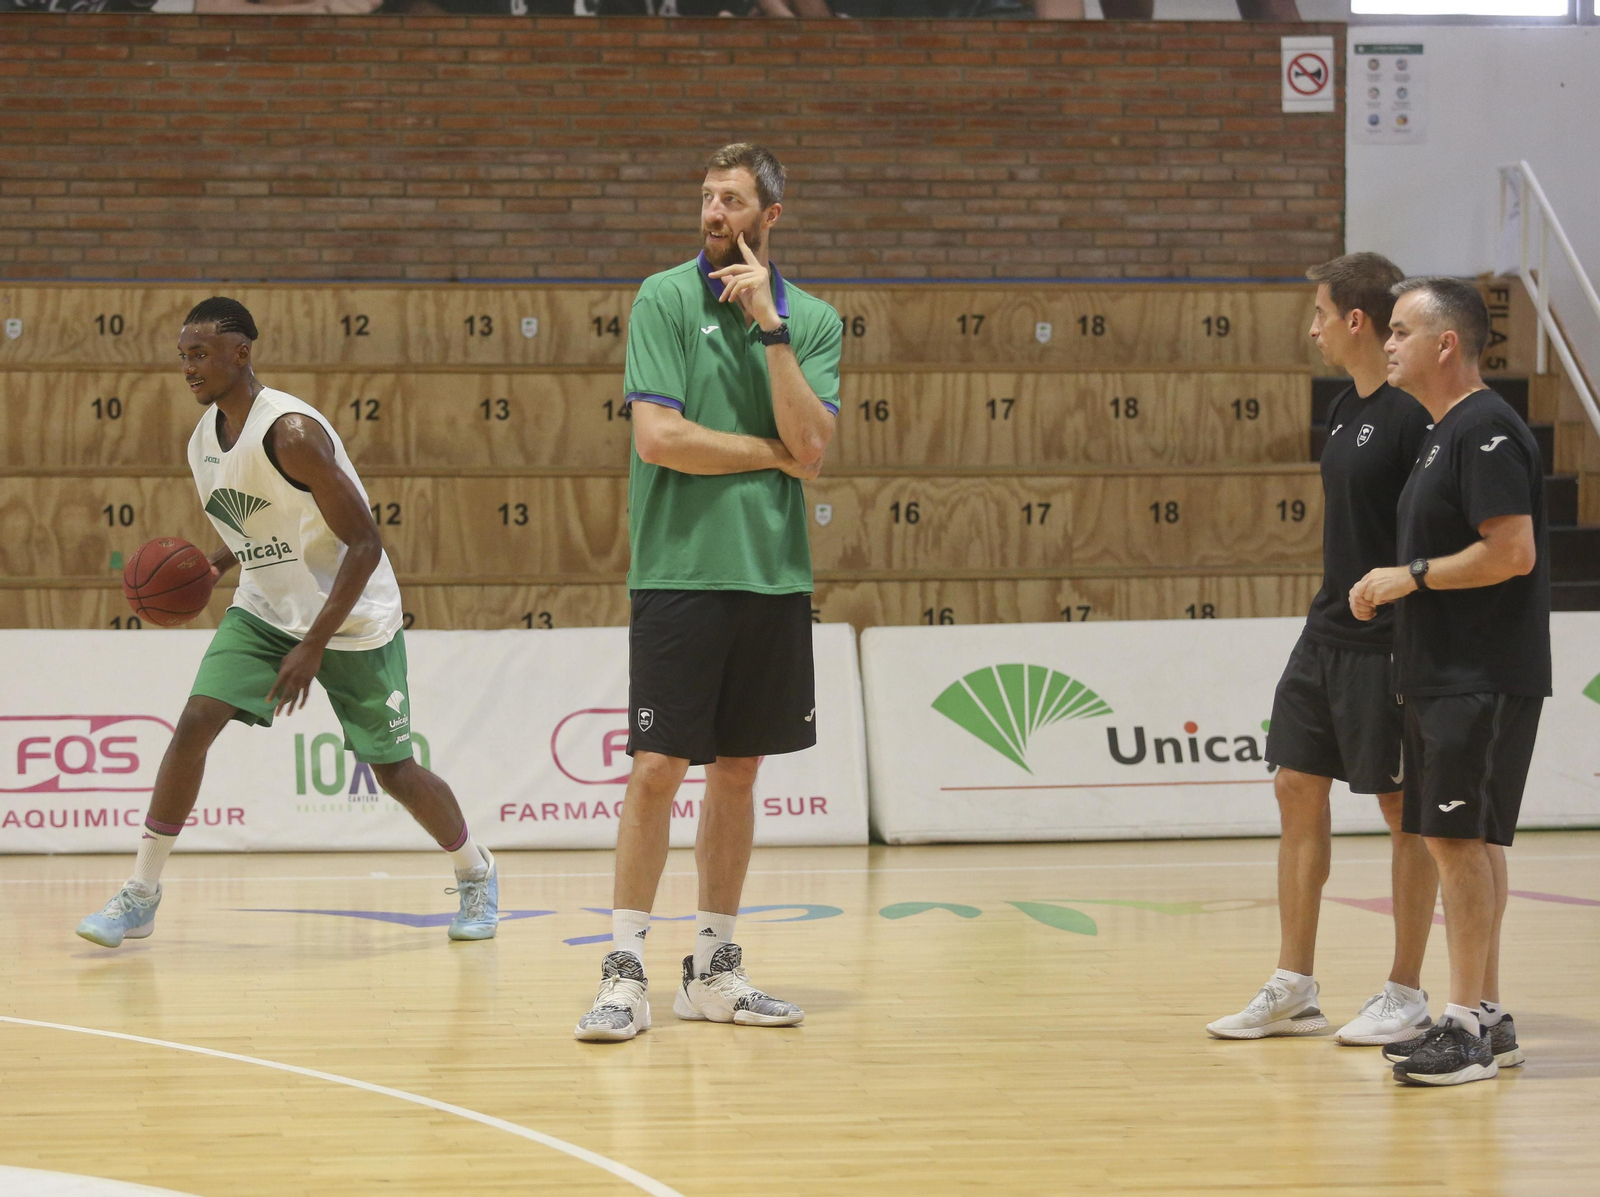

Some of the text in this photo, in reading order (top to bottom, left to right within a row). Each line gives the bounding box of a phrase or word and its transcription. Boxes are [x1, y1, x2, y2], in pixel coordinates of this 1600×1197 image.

[94, 314, 125, 336] 10
[340, 314, 370, 337] 12
[464, 314, 493, 337] 13
[592, 315, 622, 337] 14
[957, 313, 986, 336] 17
[1077, 314, 1106, 337] 18
[1202, 315, 1231, 338] 19
[1486, 356, 1508, 370] 5
[91, 396, 122, 420] 10
[350, 398, 381, 421] 12
[479, 397, 511, 421] 13
[602, 398, 632, 422] 14
[859, 398, 890, 422] 16
[986, 397, 1016, 420] 17
[1109, 396, 1140, 420] 18
[1230, 398, 1260, 421] 19
[102, 503, 135, 527] 10
[373, 502, 402, 526] 12
[497, 502, 529, 527] 13
[889, 500, 920, 525] 16
[1021, 502, 1052, 526] 17
[1148, 500, 1180, 525] 18
[1276, 498, 1307, 523] 19
[234, 536, 293, 563] nicaja
[109, 615, 142, 629] 10
[521, 611, 553, 629] 13
[1059, 605, 1092, 622] 17
[17, 735, 140, 775] FQS
[2, 808, 246, 828] AQUIMIC SUR
[764, 797, 828, 816] SUR
